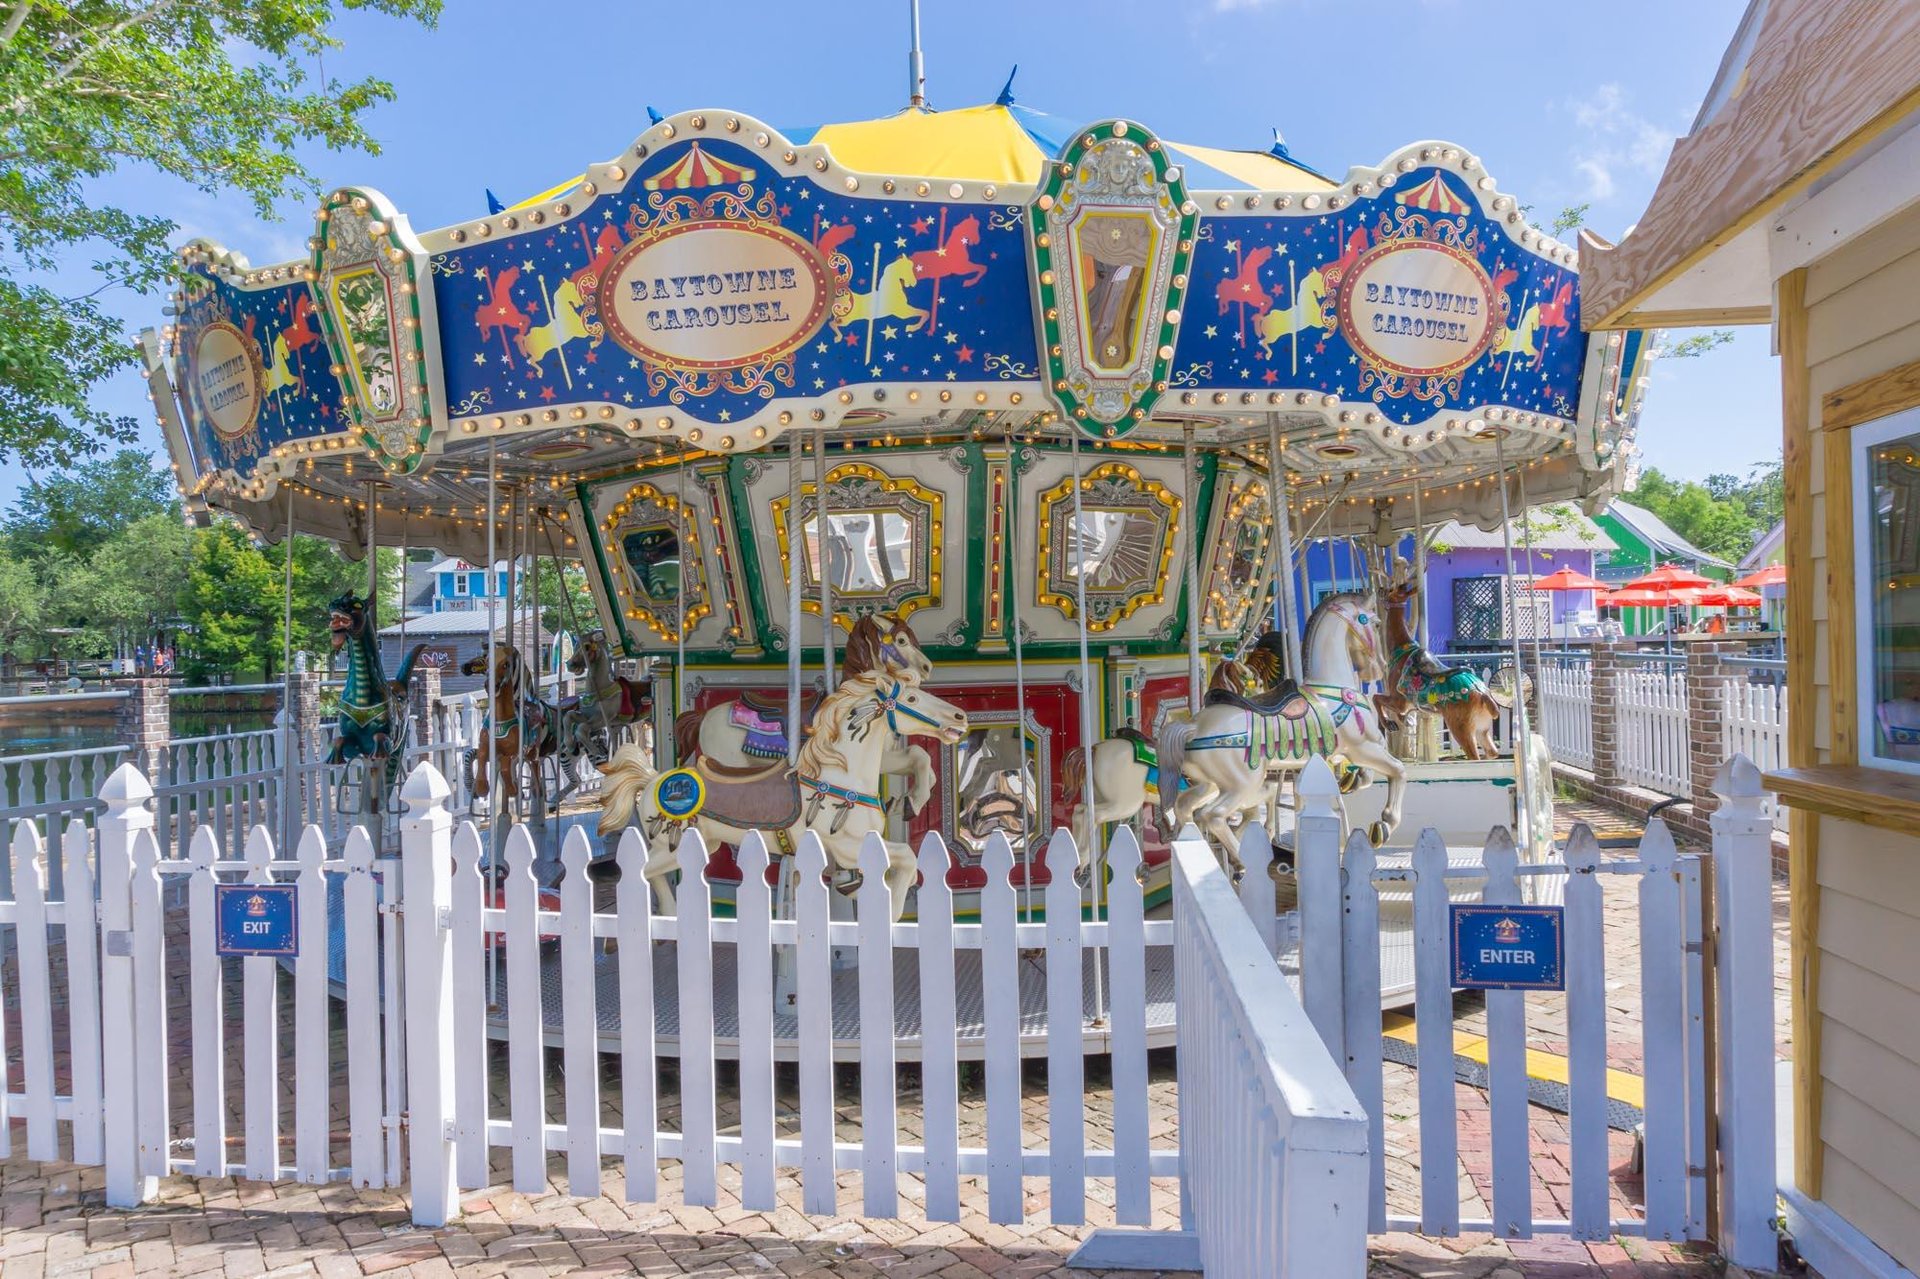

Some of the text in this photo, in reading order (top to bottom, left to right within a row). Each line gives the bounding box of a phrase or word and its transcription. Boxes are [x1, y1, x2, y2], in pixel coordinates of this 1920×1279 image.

[630, 267, 797, 301] BAYTOWNE
[1365, 282, 1478, 316] BAYTOWNE
[646, 301, 790, 331] CAROUSEL
[1372, 313, 1469, 343] CAROUSEL
[243, 921, 271, 934] EXIT
[1480, 949, 1536, 965] ENTER
